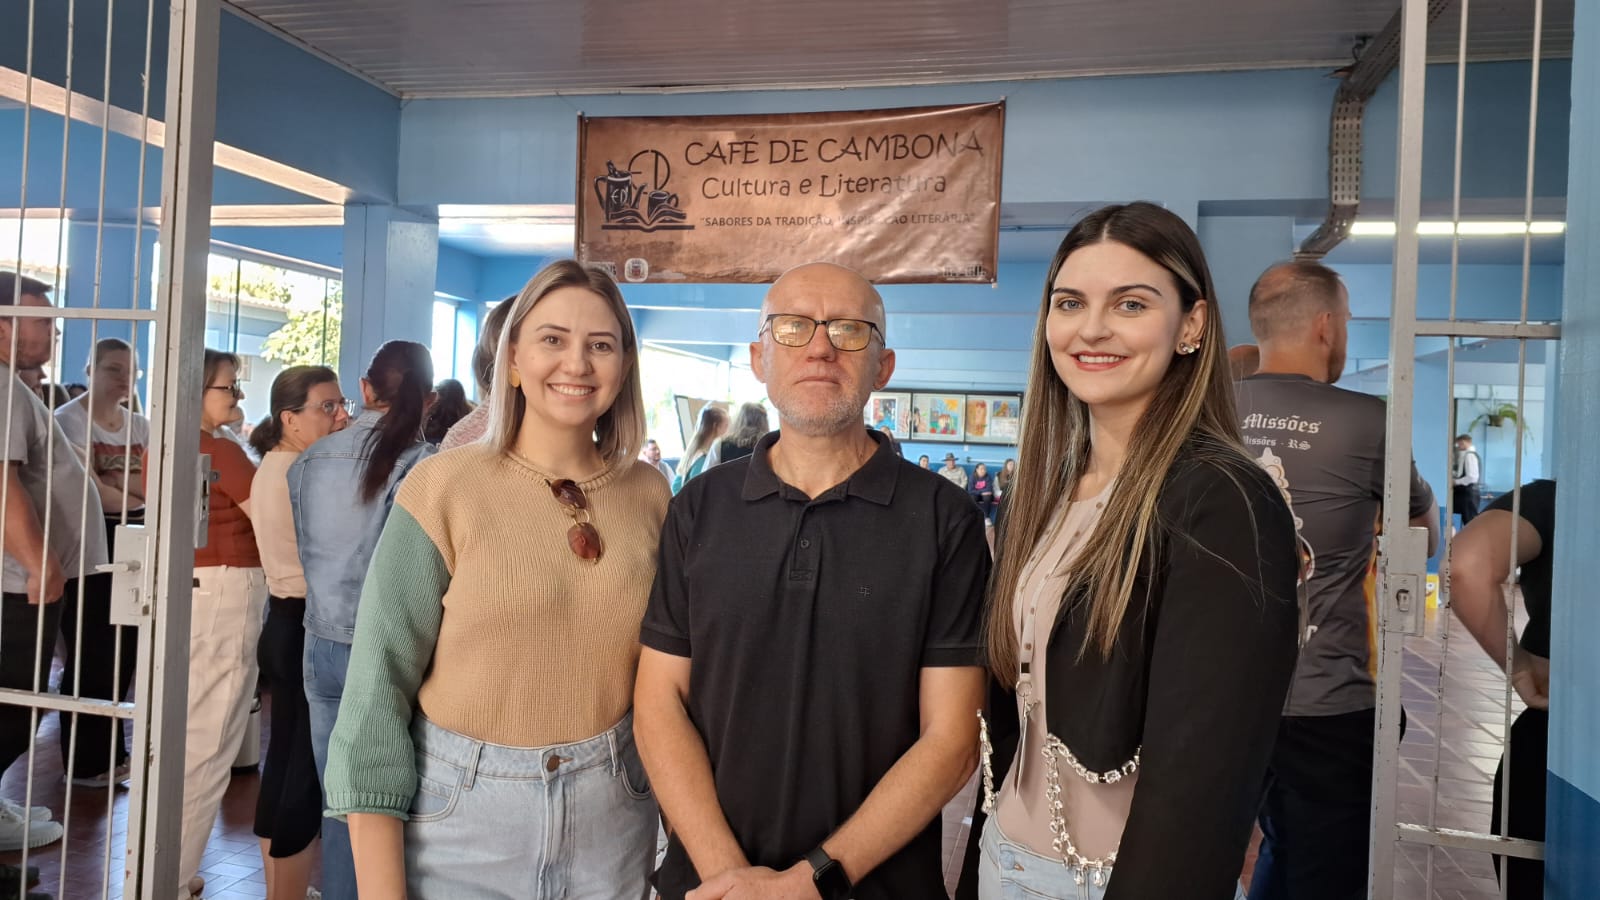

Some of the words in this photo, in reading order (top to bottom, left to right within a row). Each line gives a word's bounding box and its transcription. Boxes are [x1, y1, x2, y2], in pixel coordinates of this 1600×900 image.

[685, 134, 759, 165] CAFÉ
[768, 139, 809, 164] DE
[818, 130, 984, 163] CAMBONA
[702, 177, 791, 199] Cultura
[799, 178, 812, 194] e
[819, 174, 946, 197] Literatura
[756, 216, 772, 226] DA
[1241, 413, 1322, 434] Missões
[1287, 438, 1311, 450] RS
